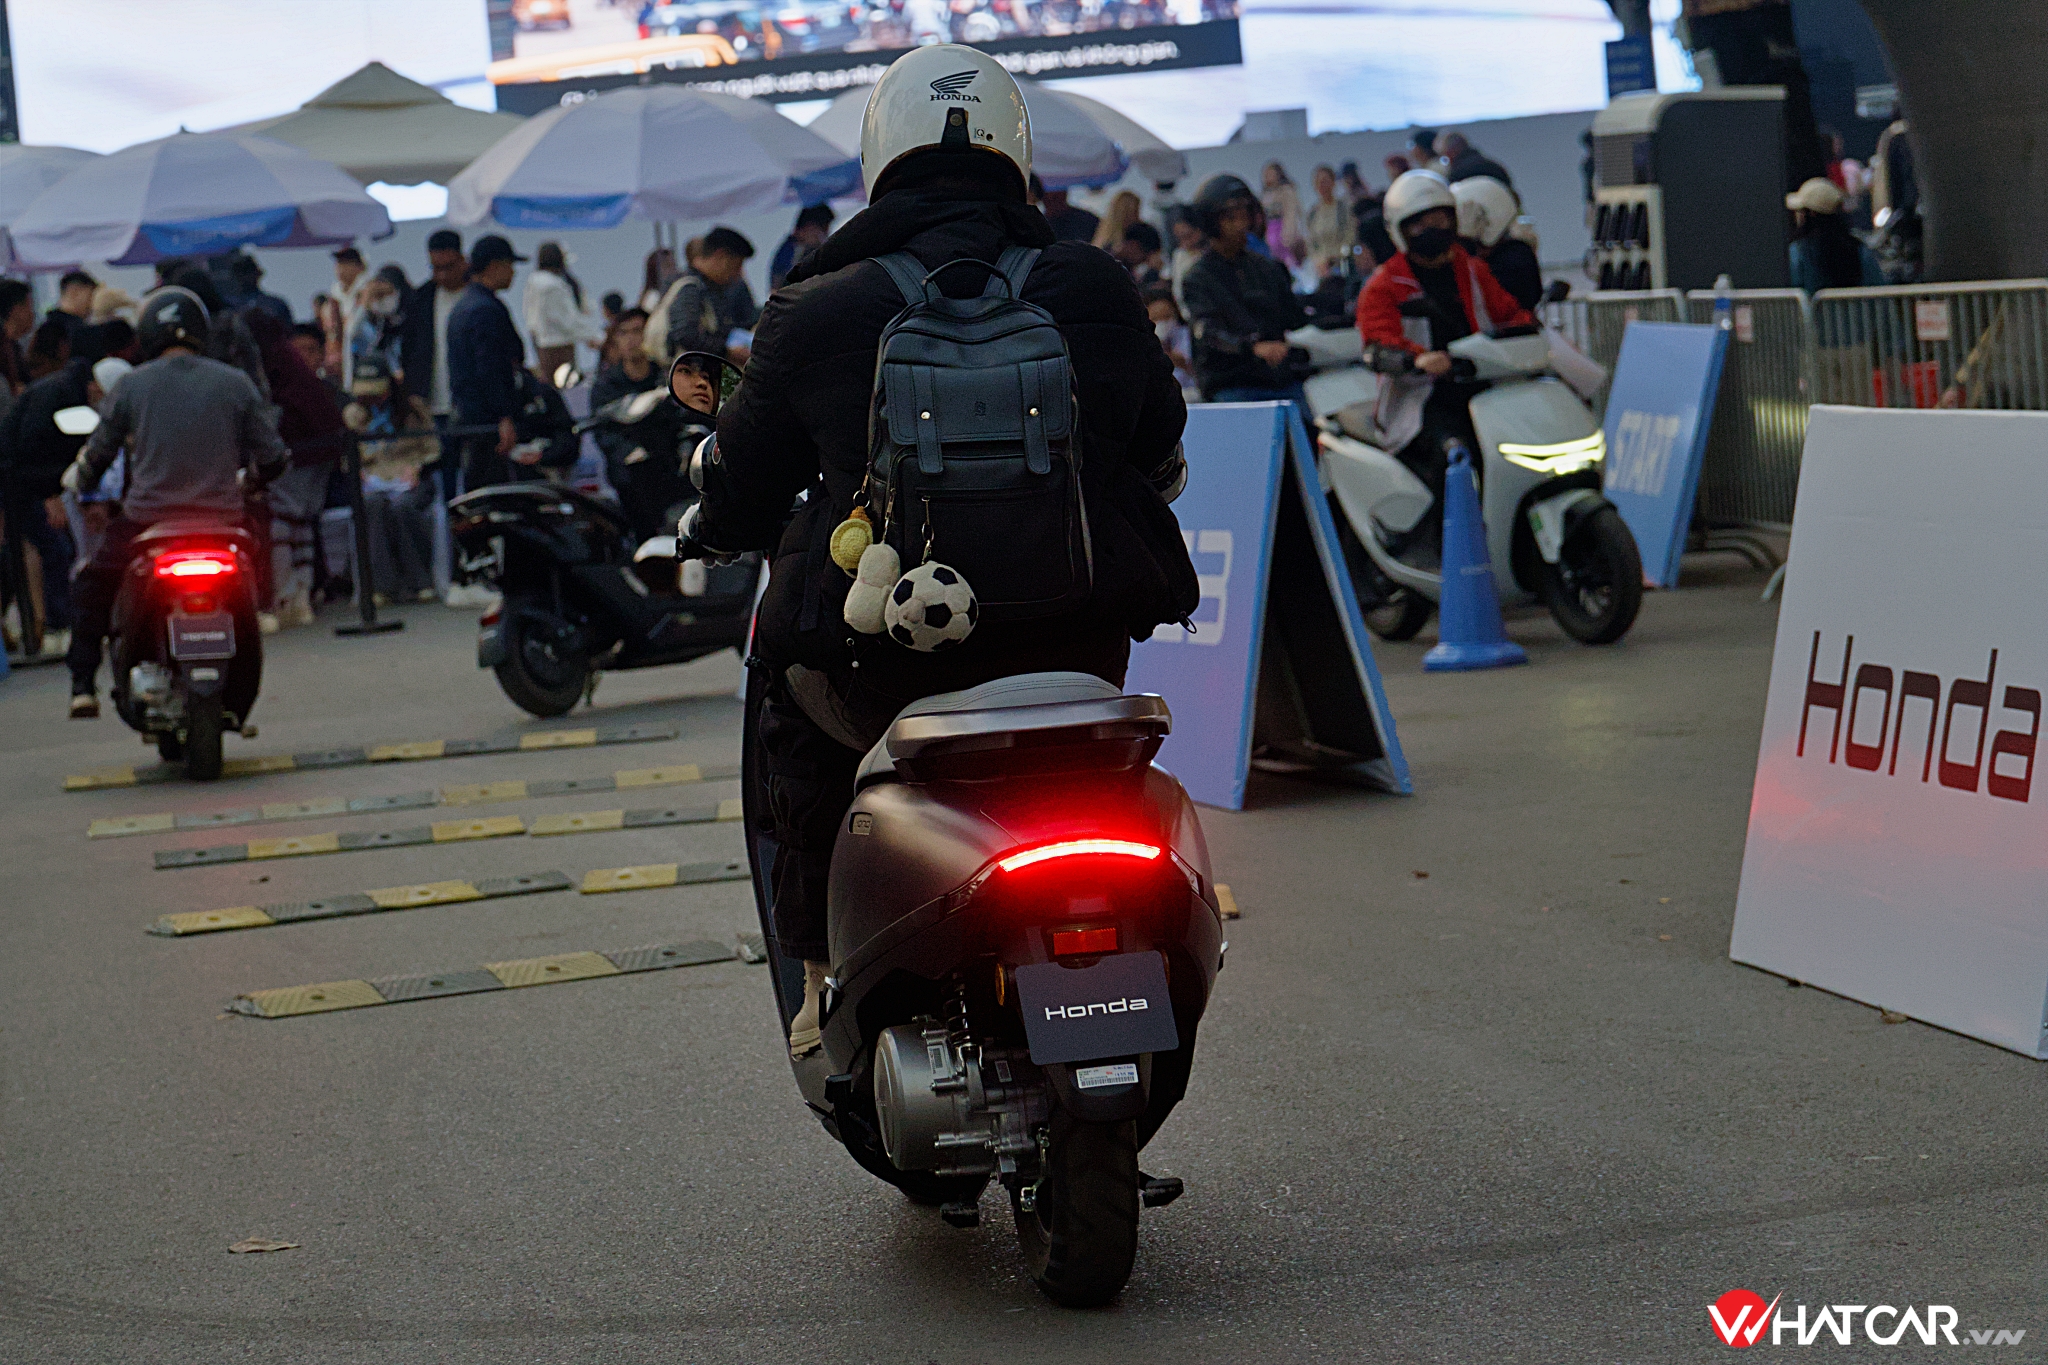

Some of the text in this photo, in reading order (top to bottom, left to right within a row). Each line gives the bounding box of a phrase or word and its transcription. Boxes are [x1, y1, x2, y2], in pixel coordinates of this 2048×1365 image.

[930, 93, 982, 103] HONDA
[1605, 409, 1680, 497] START
[1796, 630, 2042, 803] Honda
[1044, 997, 1149, 1021] Honda
